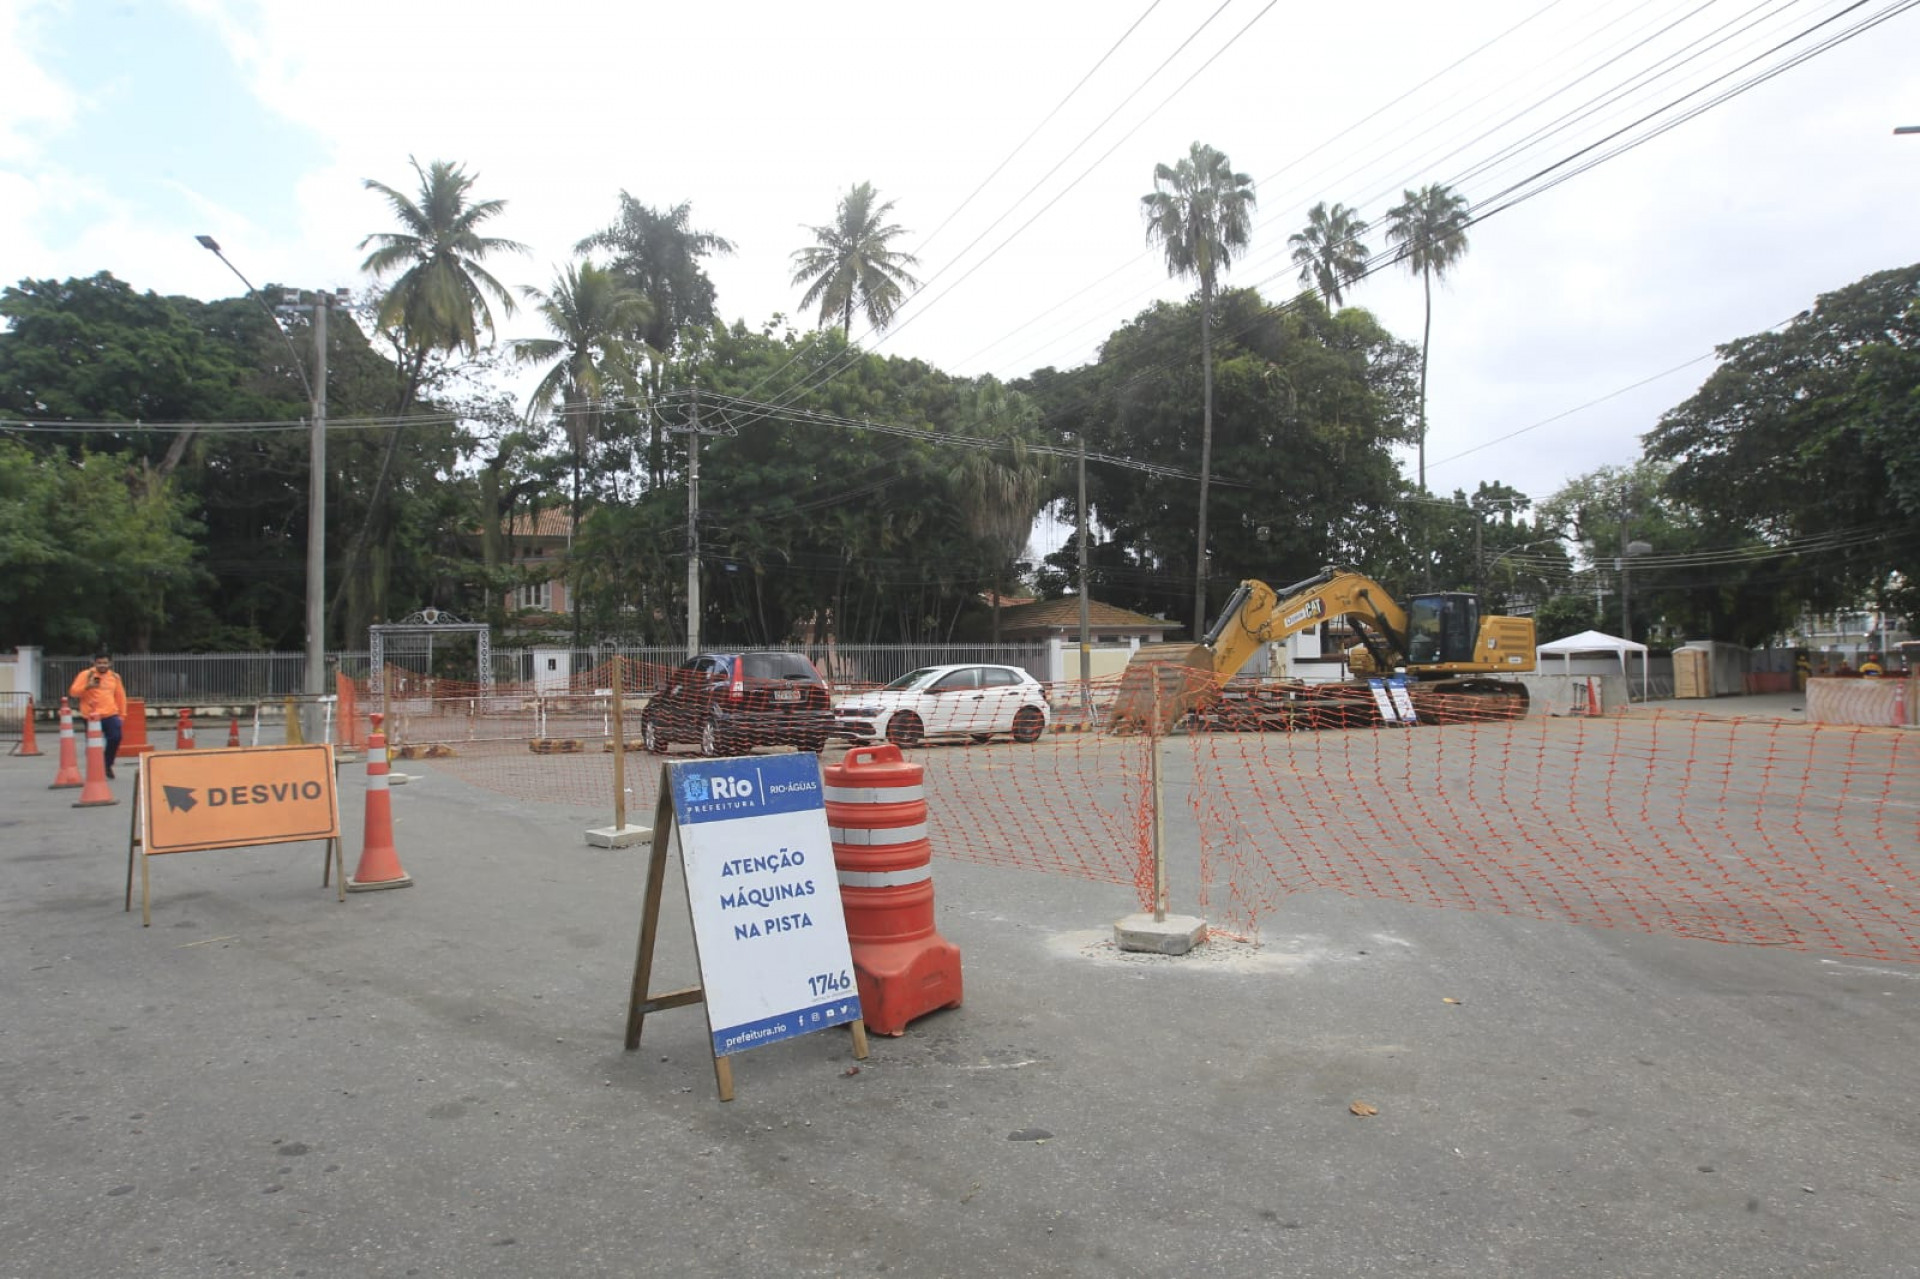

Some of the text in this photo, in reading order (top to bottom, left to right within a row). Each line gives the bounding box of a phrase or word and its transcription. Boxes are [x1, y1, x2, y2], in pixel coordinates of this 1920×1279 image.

[1305, 598, 1321, 618] CAT
[208, 780, 322, 807] DESVIO
[710, 775, 753, 799] Rio
[687, 800, 755, 813] PREFEITURA
[721, 847, 805, 877] ATENÇÃO
[720, 880, 816, 910] MÁQUINAS
[734, 912, 813, 941] NA PISTA
[808, 970, 850, 997] 1746
[725, 1022, 787, 1048] prefeitura.rio
